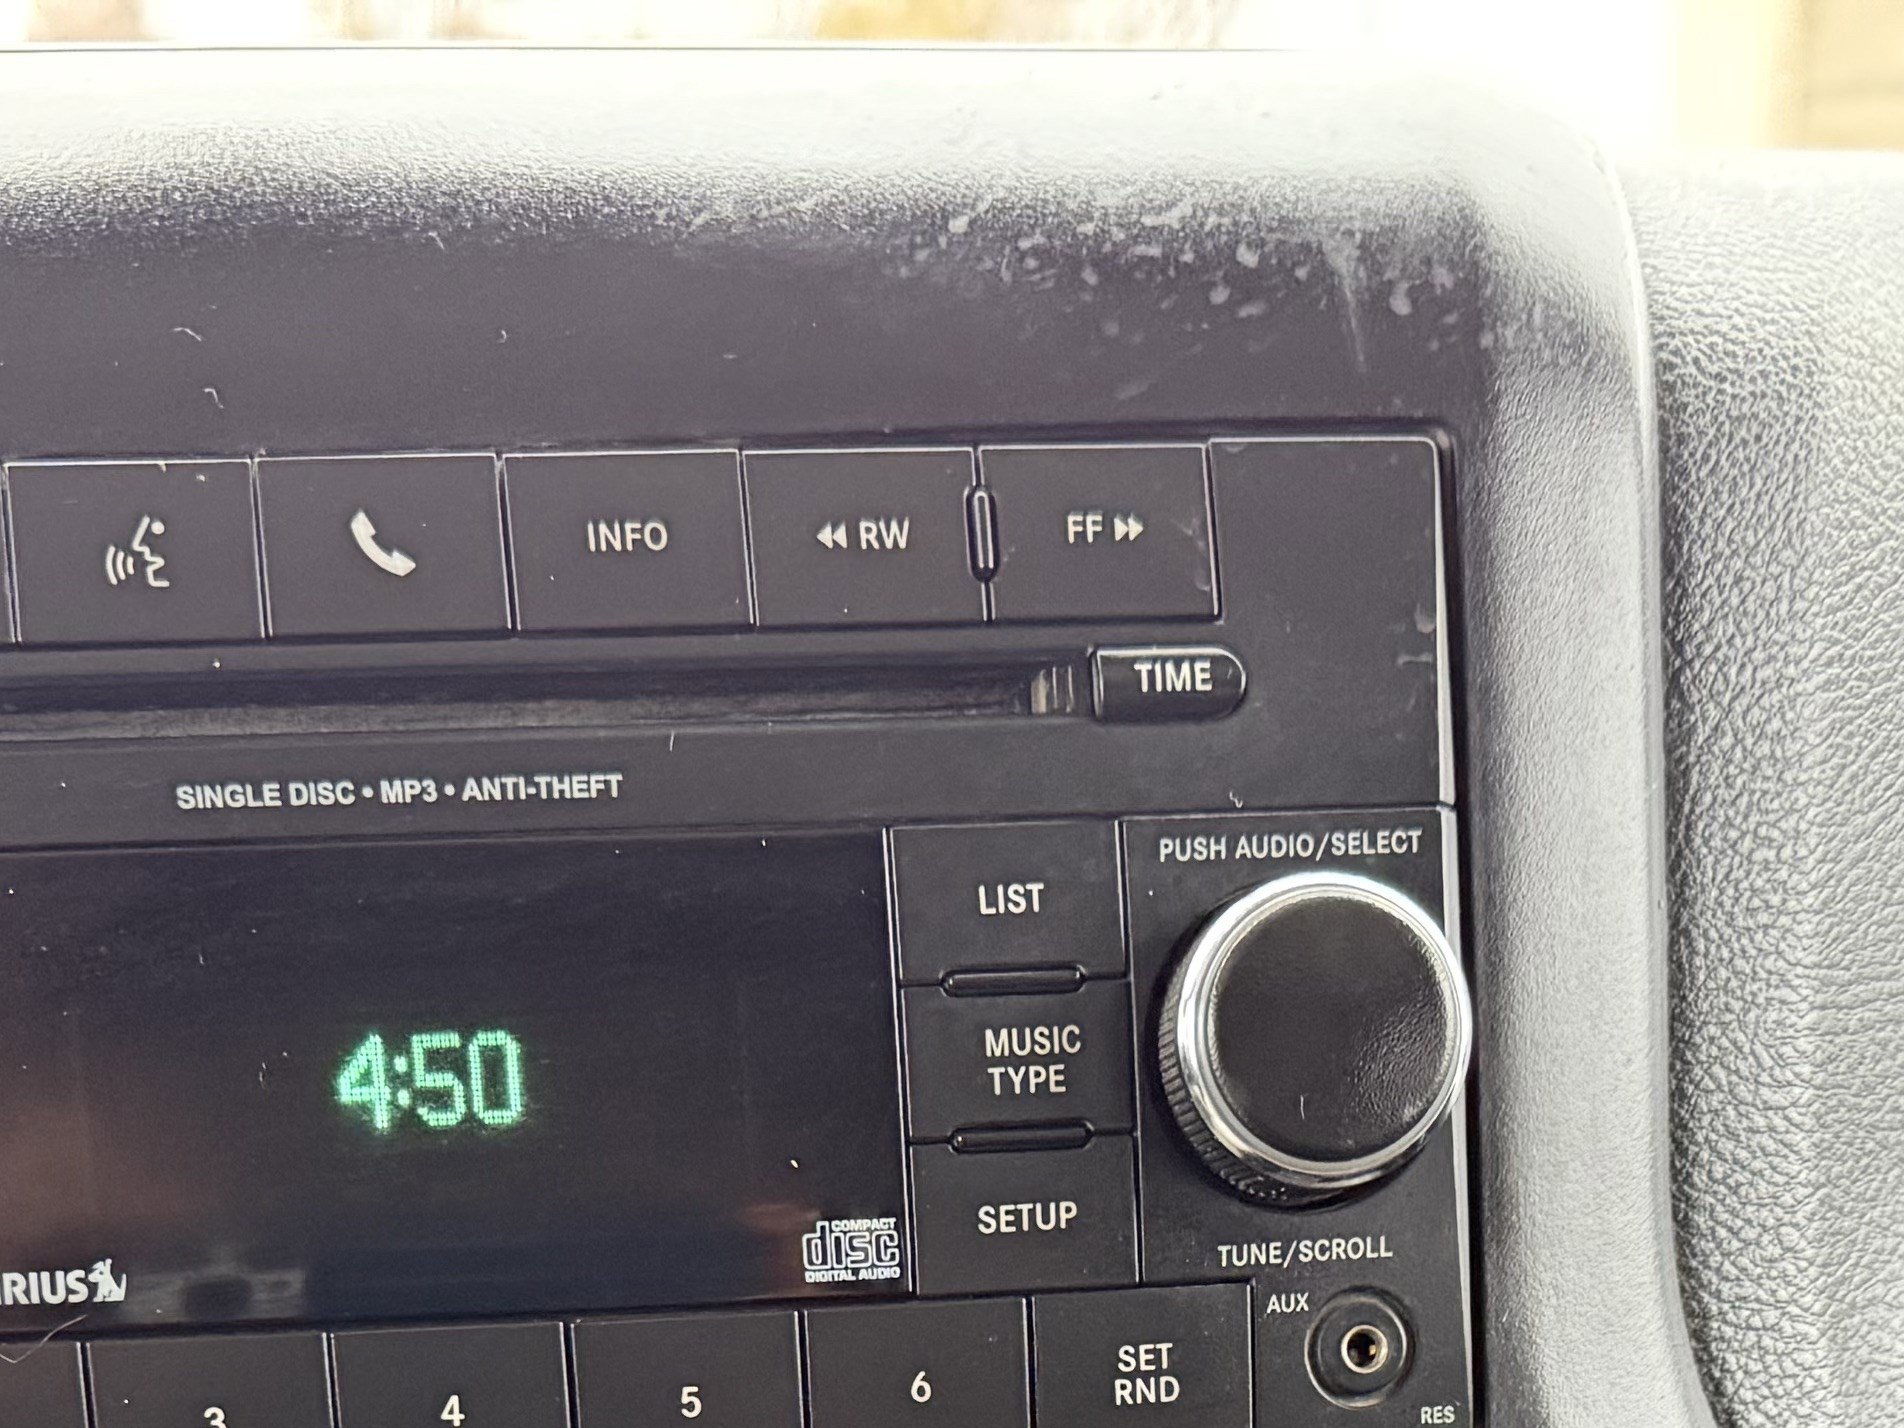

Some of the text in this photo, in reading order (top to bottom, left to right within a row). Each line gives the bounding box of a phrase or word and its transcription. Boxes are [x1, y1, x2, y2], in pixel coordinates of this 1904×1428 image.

[587, 519, 668, 553] INFO
[858, 516, 910, 550] RW
[1067, 513, 1103, 544] FF
[1133, 661, 1214, 694] TIME
[175, 773, 624, 810] SINGLE DISC MP3 ANTI-THEFT
[1159, 828, 1423, 863] PUSH AUDIO/SELECT
[978, 882, 1045, 915] LIST
[984, 1024, 1082, 1058] MUSIC
[337, 1029, 522, 1130] 4:50
[987, 1063, 1067, 1096] TYPE
[831, 1217, 897, 1232] COMPACT
[977, 1200, 1078, 1235] SETUP
[1217, 1234, 1394, 1269] TUNE/SCROLL
[804, 1266, 901, 1283] DIGITAL AUDIO
[1266, 1291, 1309, 1314] AUX
[1117, 1342, 1173, 1373] SET
[680, 1386, 702, 1419] 5
[910, 1370, 932, 1403] 6
[1114, 1375, 1180, 1406] RND
[440, 1394, 466, 1427] 4
[1420, 1404, 1456, 1425] RES
